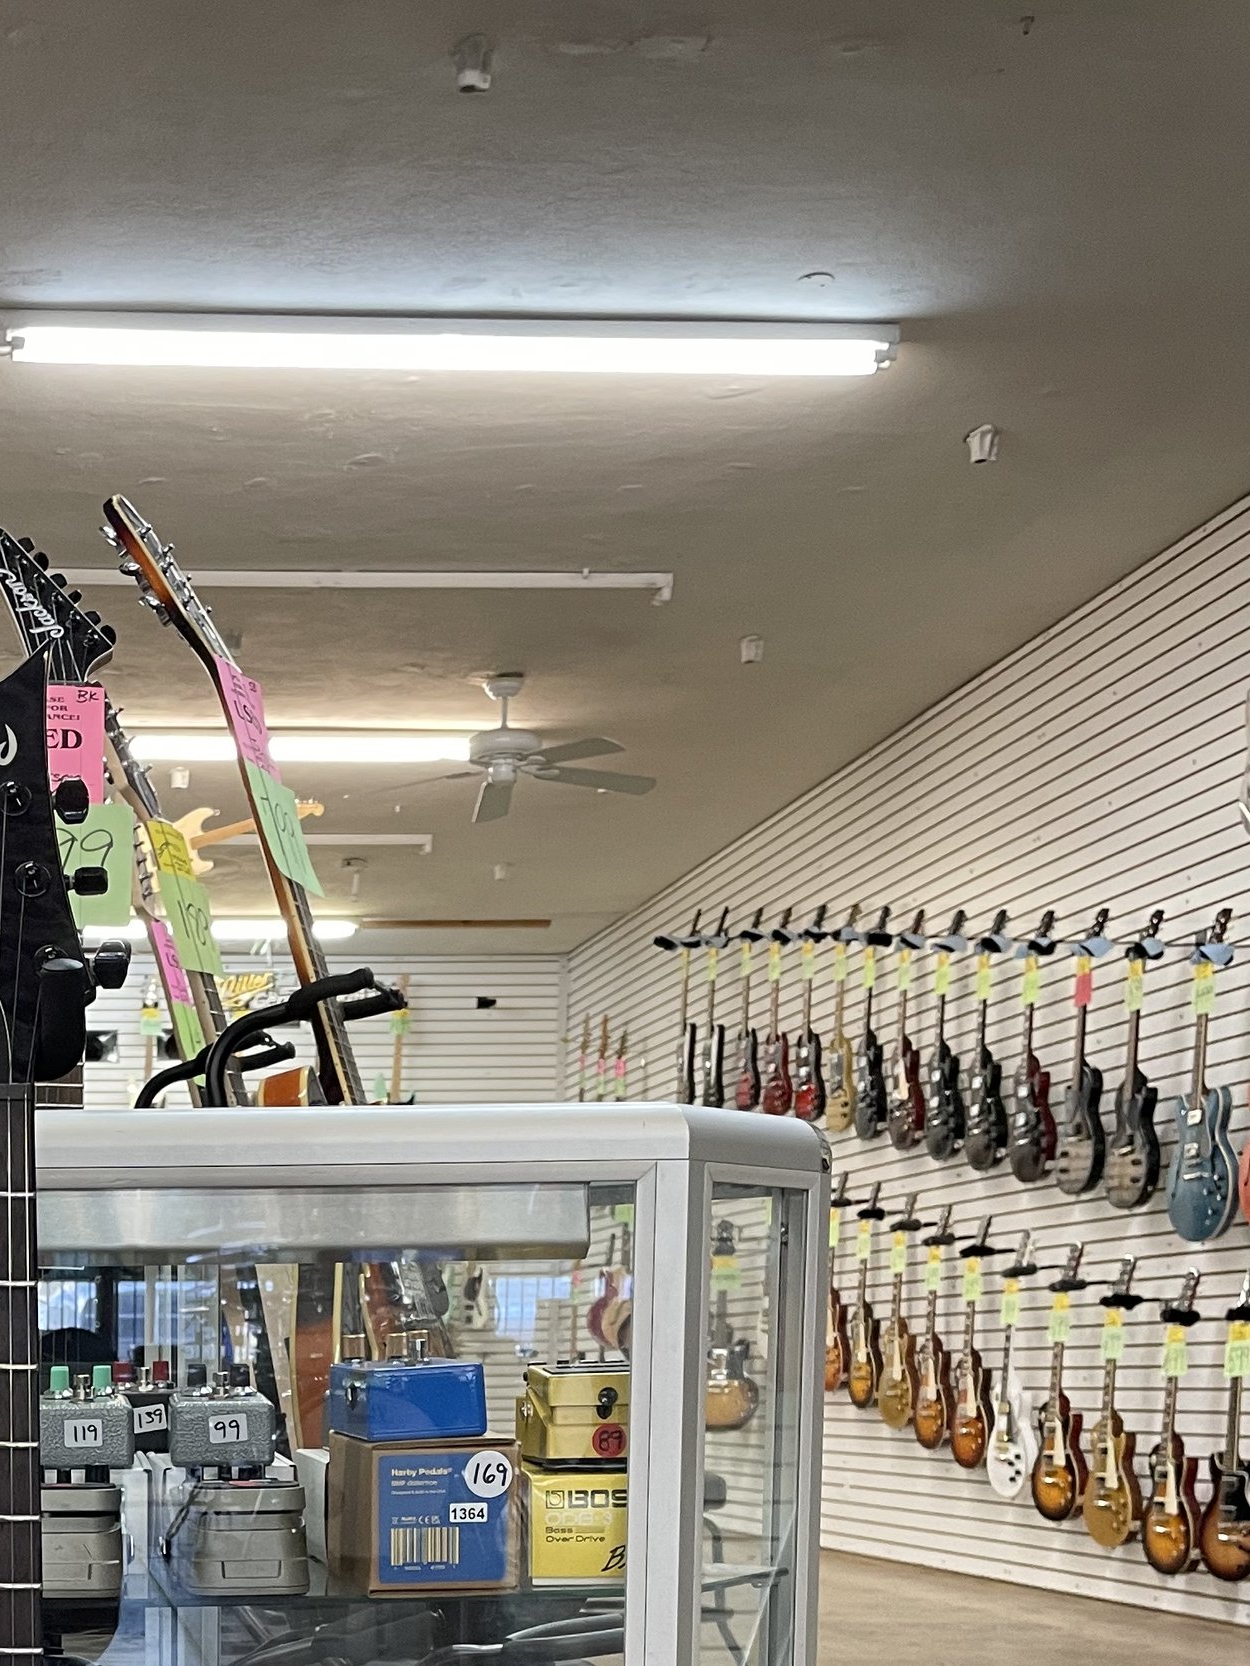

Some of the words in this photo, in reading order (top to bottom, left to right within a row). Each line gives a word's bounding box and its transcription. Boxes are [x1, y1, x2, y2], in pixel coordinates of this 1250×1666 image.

[73, 1424, 98, 1443] 119
[213, 1419, 240, 1440] 99
[472, 1462, 508, 1487] 169
[450, 1507, 486, 1520] 1364
[545, 1526, 573, 1534] Bass
[545, 1535, 574, 1543] Over
[575, 1535, 606, 1543] Drive
